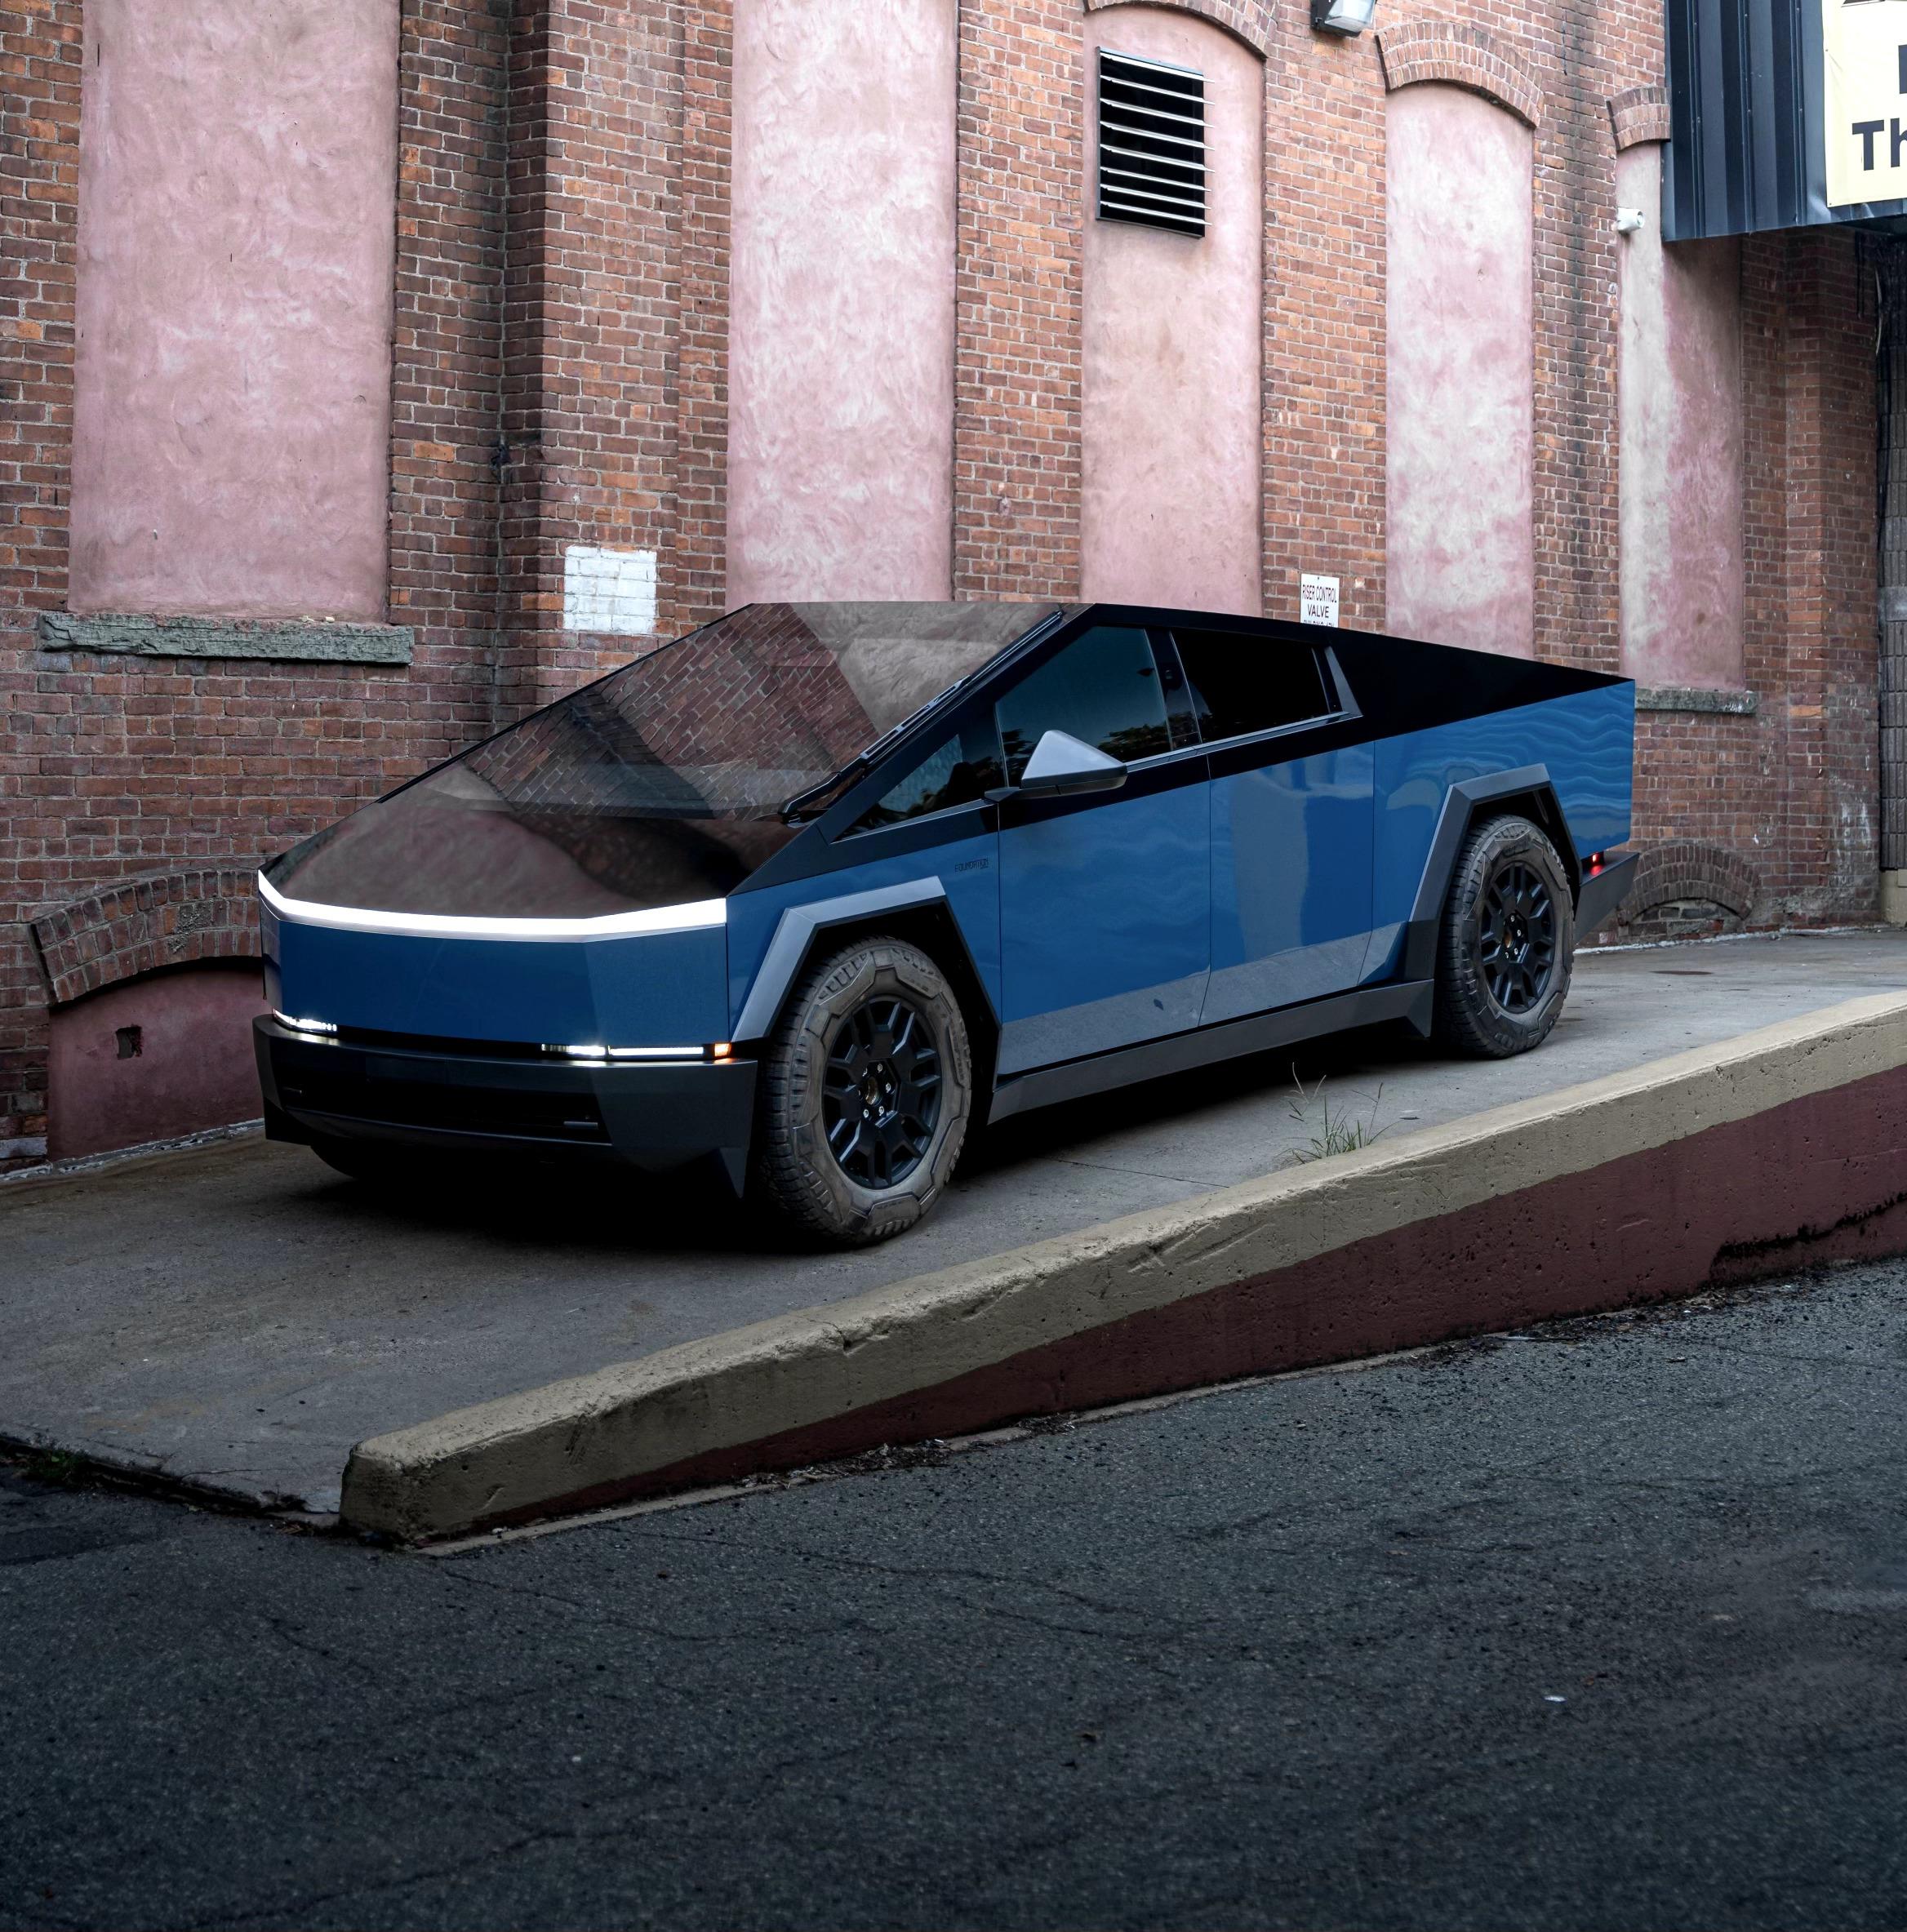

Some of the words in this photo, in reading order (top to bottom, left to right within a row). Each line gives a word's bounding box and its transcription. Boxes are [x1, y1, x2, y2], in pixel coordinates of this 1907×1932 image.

[1302, 584, 1315, 600] RISER
[1316, 585, 1337, 603] CONTROL
[1307, 603, 1330, 618] VALVE
